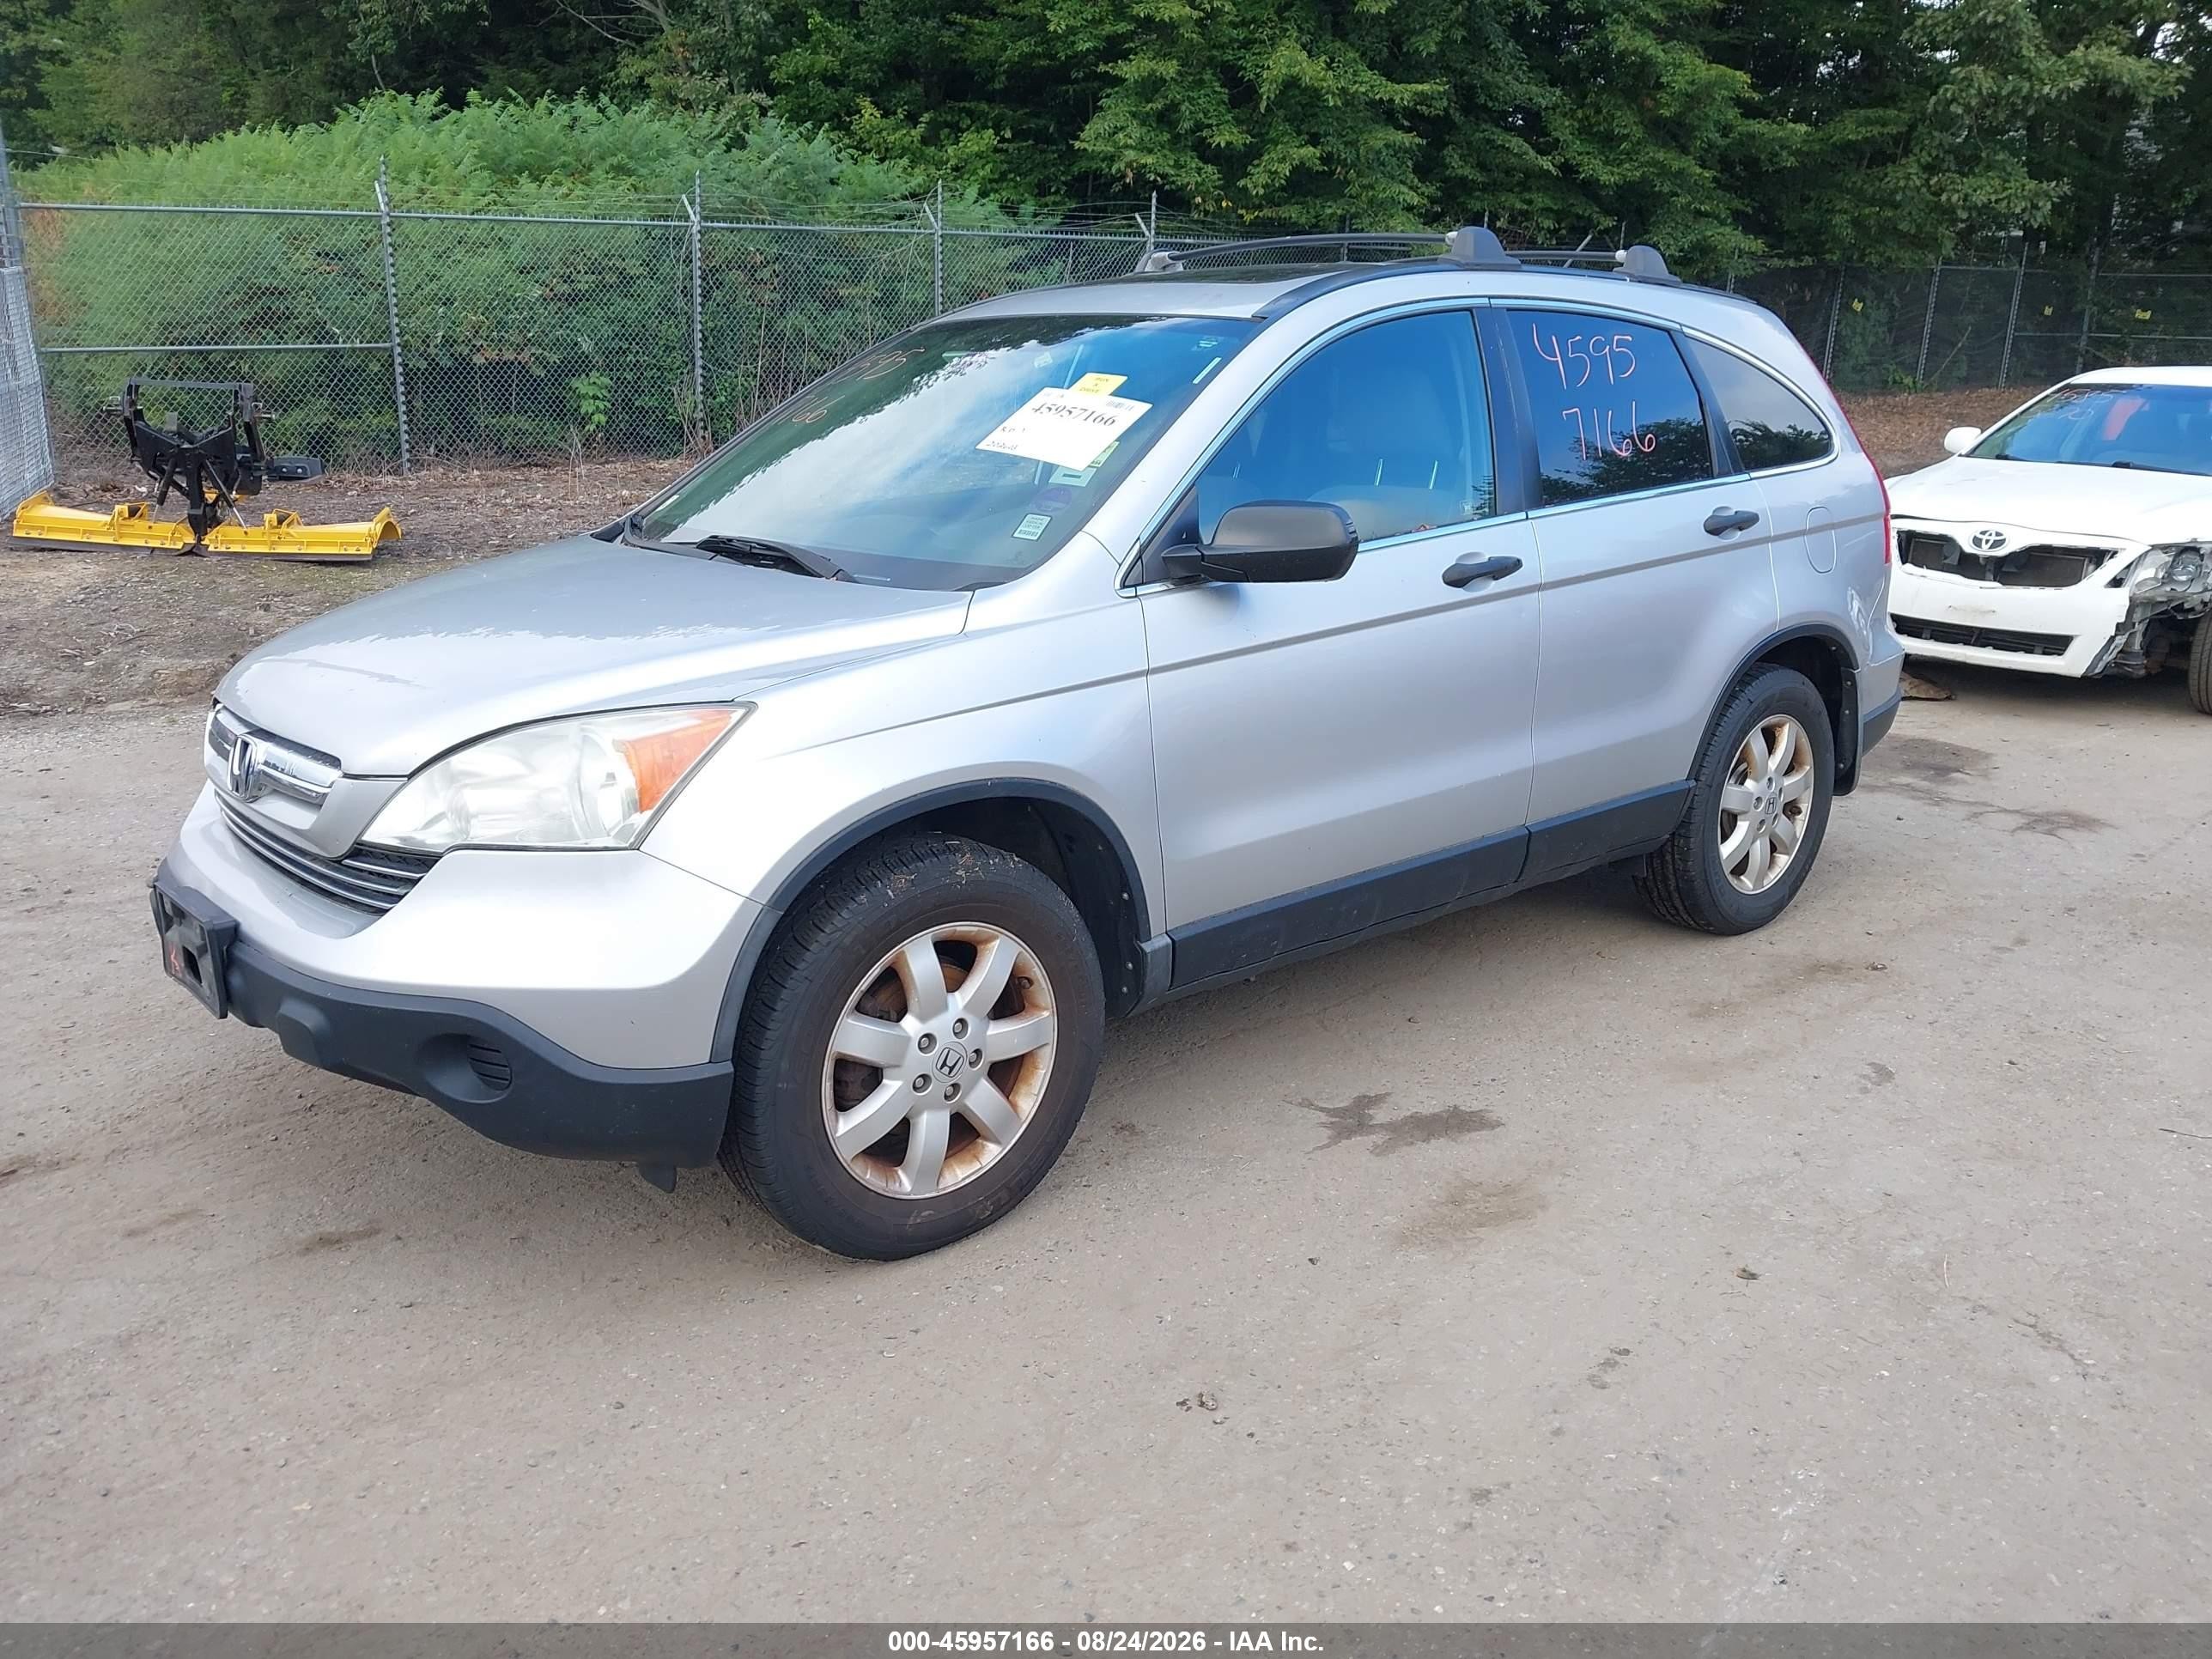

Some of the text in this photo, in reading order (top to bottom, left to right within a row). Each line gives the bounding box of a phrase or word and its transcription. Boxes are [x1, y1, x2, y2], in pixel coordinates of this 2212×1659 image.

[1532, 322, 1637, 390] 4595
[1031, 401, 1118, 428] 45957166
[1561, 399, 1656, 461] 7166
